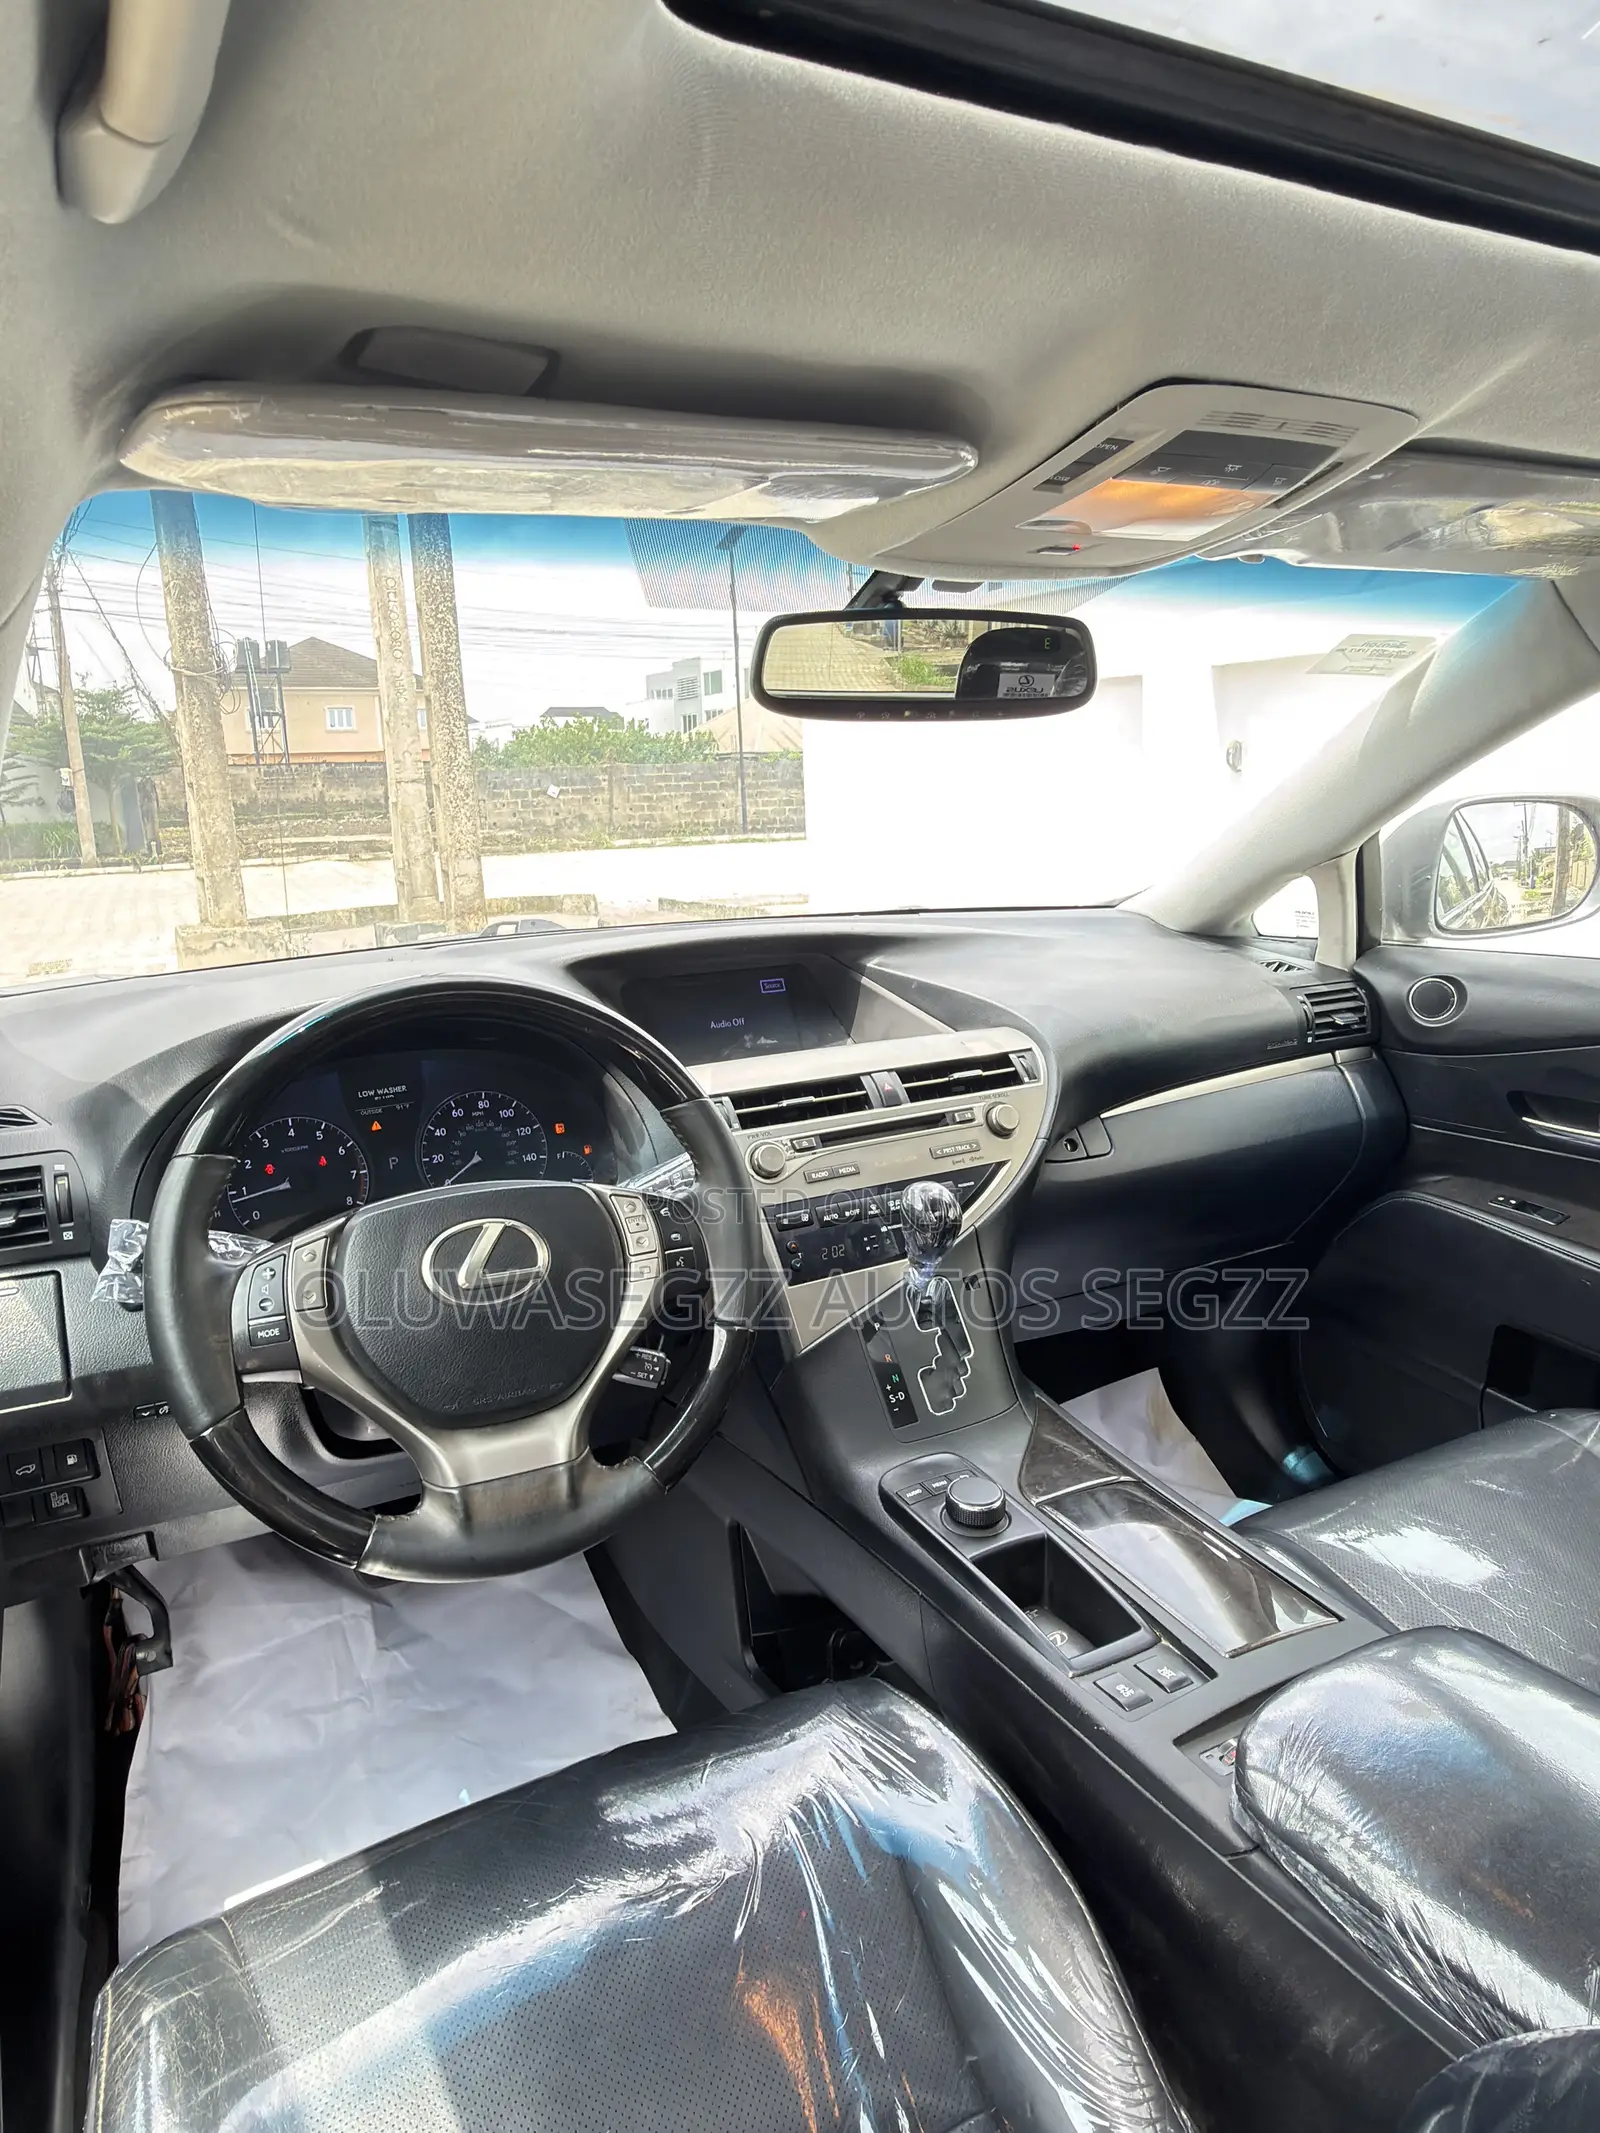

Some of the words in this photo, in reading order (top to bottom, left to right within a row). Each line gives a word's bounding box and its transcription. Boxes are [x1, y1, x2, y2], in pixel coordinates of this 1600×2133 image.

[710, 1020, 732, 1029] Audio
[732, 1017, 745, 1027] Off
[357, 1089, 375, 1098] LOW
[376, 1084, 408, 1096] WASHER
[477, 1100, 490, 1109] 80
[360, 1108, 383, 1116] OUTSIDE
[451, 1108, 464, 1118] 60
[499, 1108, 515, 1119] 100
[287, 1128, 295, 1137] 4
[316, 1130, 324, 1141] 5
[434, 1127, 447, 1137] 40
[516, 1126, 532, 1137] 120
[262, 1138, 270, 1148] 3
[955, 1143, 971, 1152] TRACK
[338, 1145, 346, 1156] 6
[432, 1153, 444, 1164] 20
[522, 1152, 537, 1163] 140
[244, 1159, 252, 1170] 2
[388, 1156, 399, 1170] P
[350, 1170, 357, 1180] 7
[811, 1170, 829, 1180] RADIO
[838, 1165, 856, 1175] MEDIA
[241, 1186, 247, 1196] 1
[346, 1196, 353, 1206] 8
[214, 1210, 221, 1218] H
[252, 1210, 261, 1221] 0
[823, 1213, 839, 1222] AUTO
[874, 1322, 880, 1331] P
[257, 1327, 280, 1339] MODE
[884, 1353, 893, 1363] R
[891, 1373, 900, 1383] N
[52, 1499, 70, 1508] BSM
